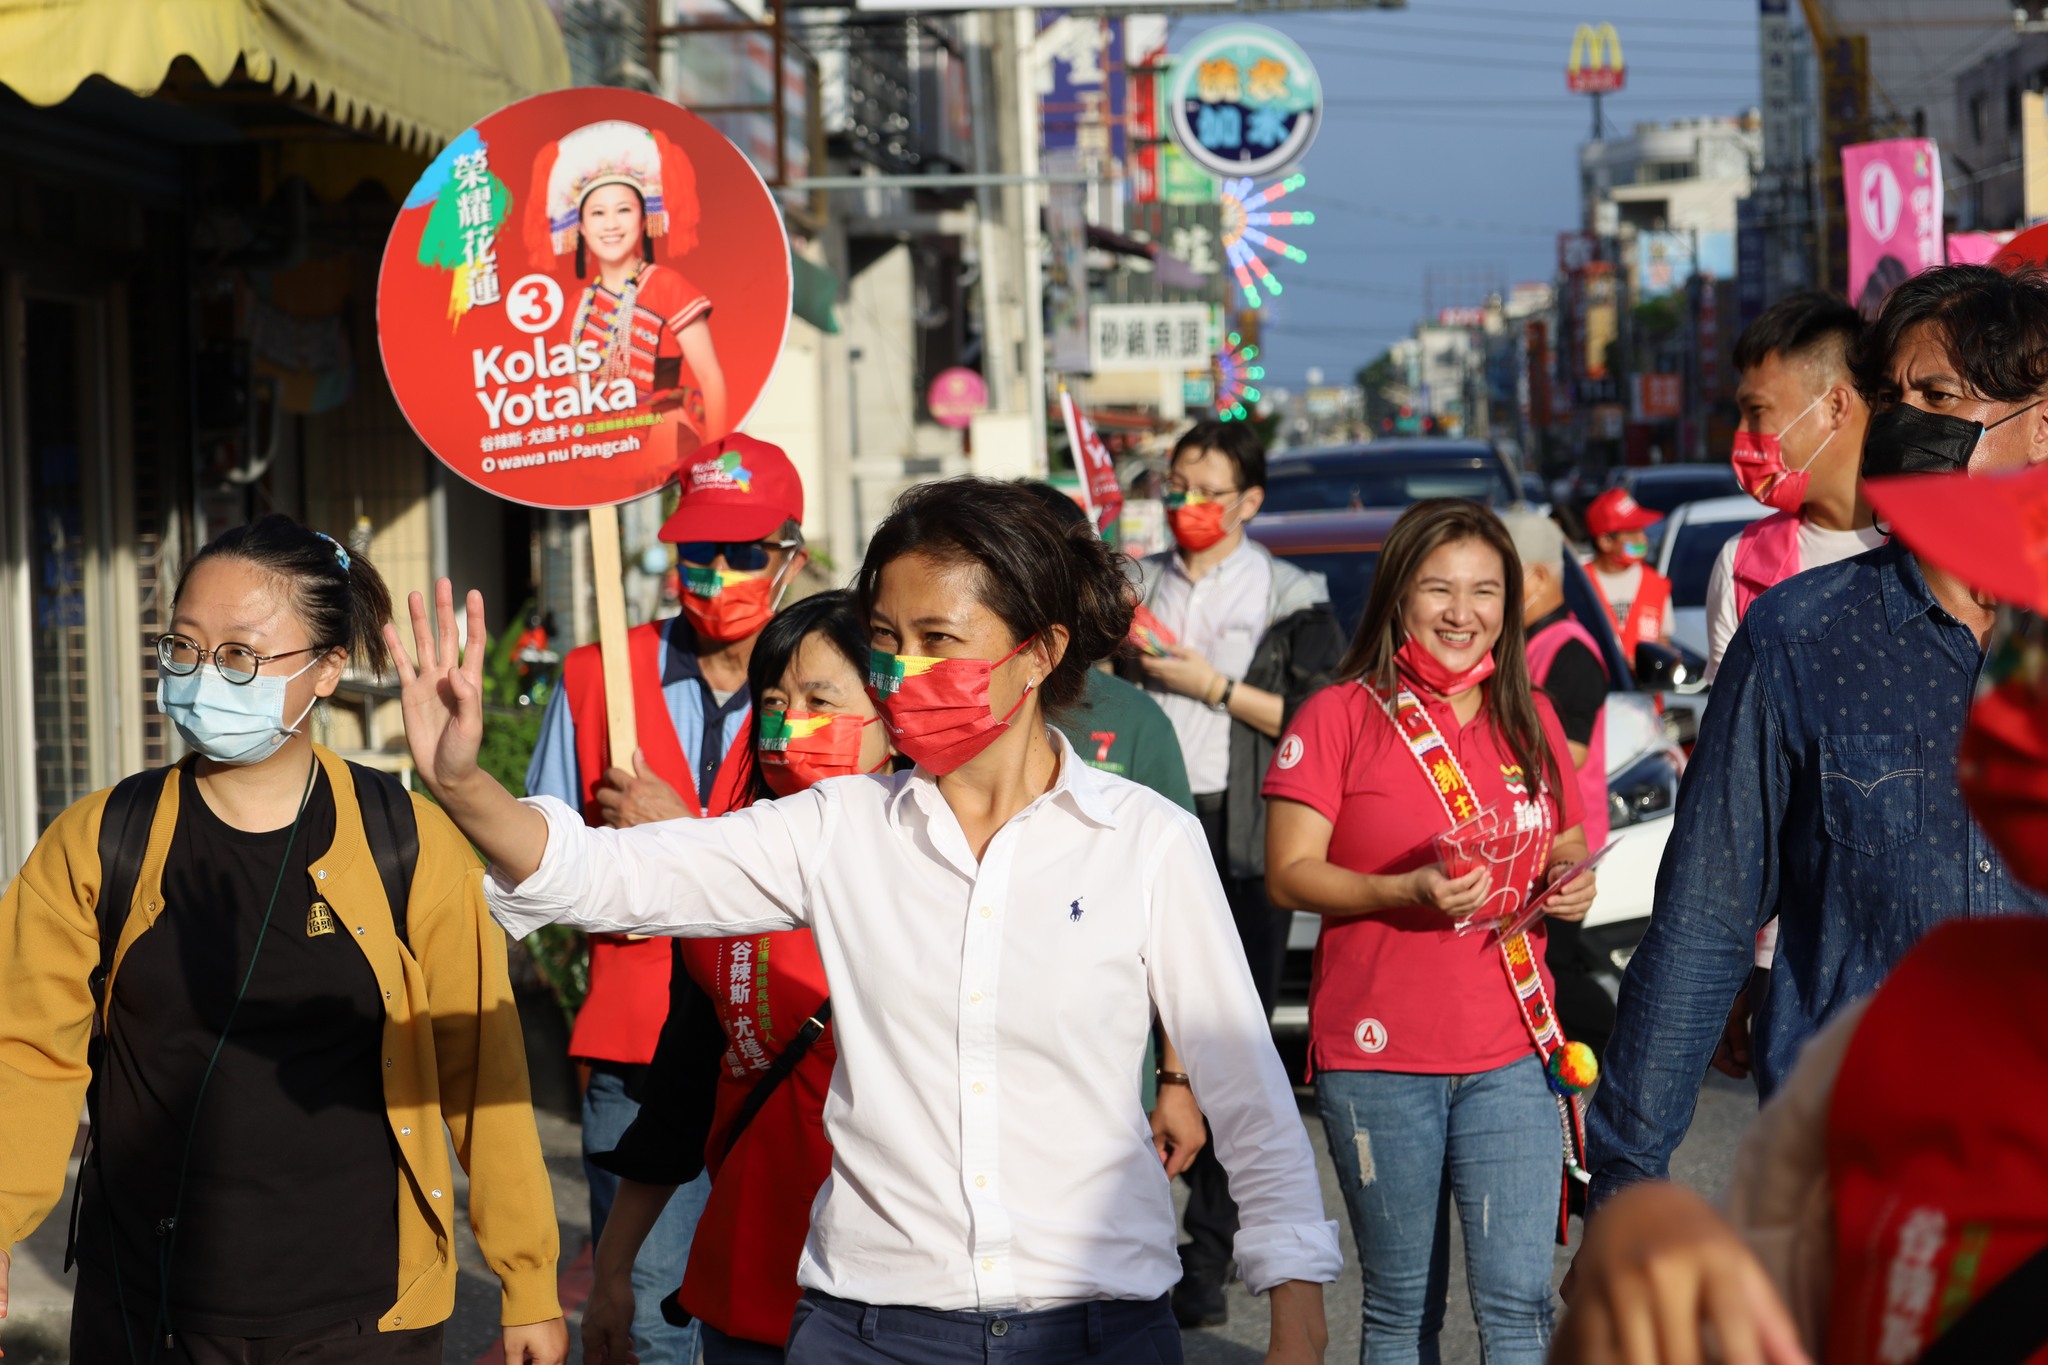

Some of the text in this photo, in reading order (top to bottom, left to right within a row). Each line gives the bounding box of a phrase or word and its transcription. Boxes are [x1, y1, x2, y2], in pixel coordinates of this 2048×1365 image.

[453, 149, 501, 310] 榮耀花蓮
[518, 281, 553, 325] 3
[472, 336, 602, 389] Kolas
[476, 373, 638, 430] Yotaka
[481, 435, 641, 473] O wawa nu Pangcah
[1091, 731, 1116, 762] 7
[729, 941, 772, 1070] 谷辣斯·尤達卡
[756, 937, 776, 1043] 花蓮縣縣長候選人
